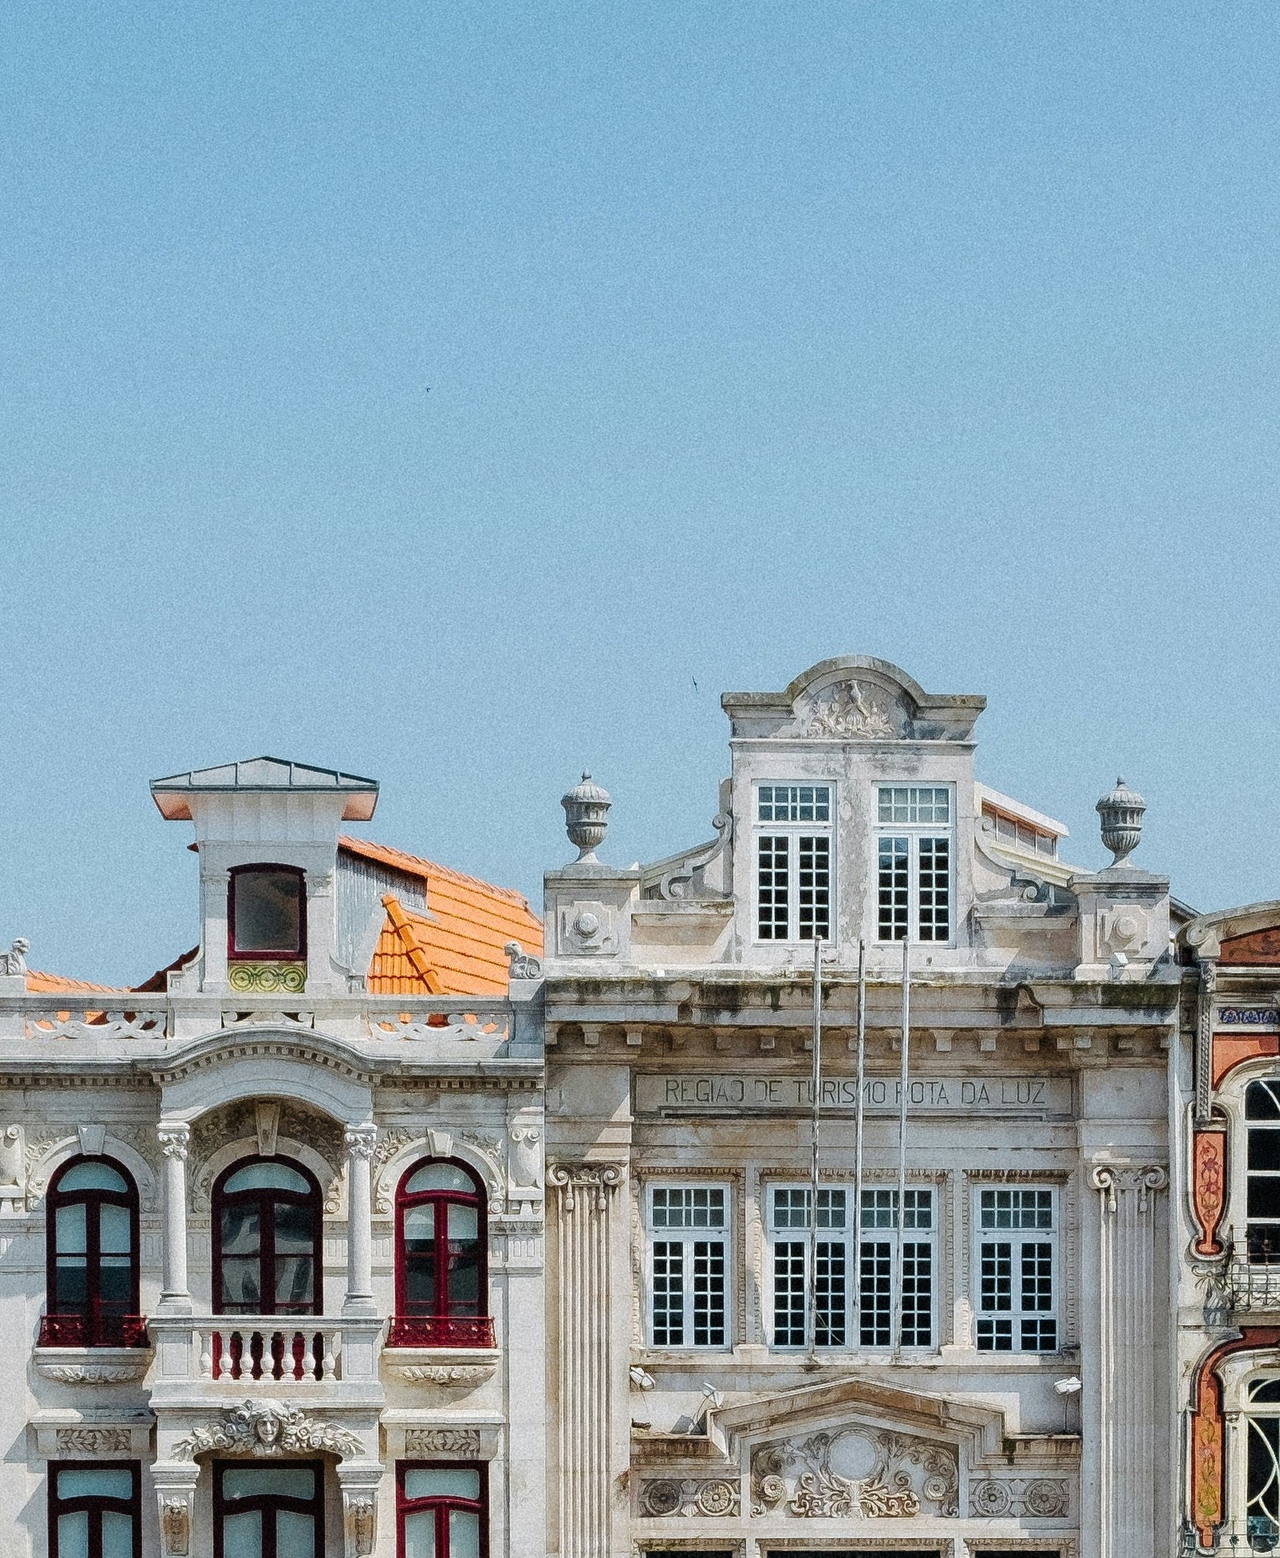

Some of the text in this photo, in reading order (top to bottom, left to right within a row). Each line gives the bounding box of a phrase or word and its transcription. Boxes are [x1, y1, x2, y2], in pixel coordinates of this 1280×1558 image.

[755, 1080, 782, 1103] DE
[793, 1080, 886, 1104] TURISMO
[896, 1081, 950, 1105] ROTA
[961, 1081, 990, 1104] DA
[1001, 1081, 1046, 1105] LUZ
